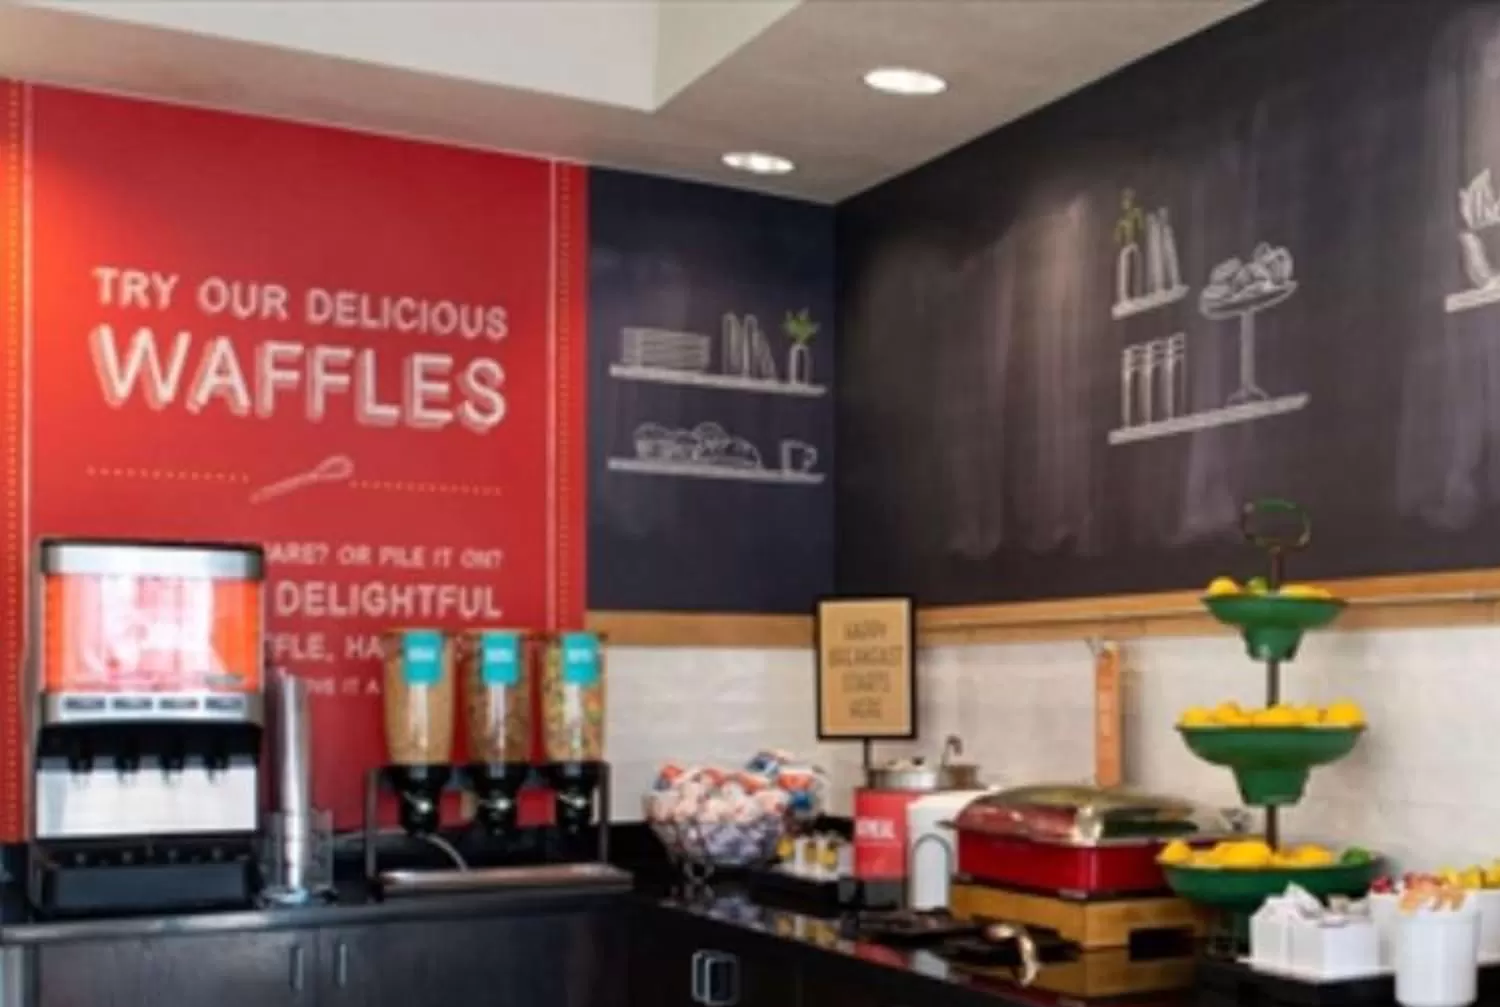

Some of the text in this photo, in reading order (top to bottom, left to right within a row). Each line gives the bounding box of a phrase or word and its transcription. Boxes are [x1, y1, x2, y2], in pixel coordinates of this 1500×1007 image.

[92, 267, 510, 341] TRY OUR DELICIOUS
[89, 323, 508, 434] WAFFLES
[263, 541, 329, 567] ARE?
[336, 543, 371, 566] OR
[378, 545, 426, 569] PILE
[433, 547, 453, 569] IT
[275, 581, 504, 621] DELIGHTFUL
[266, 631, 334, 664] FLE,
[344, 634, 386, 660] HA
